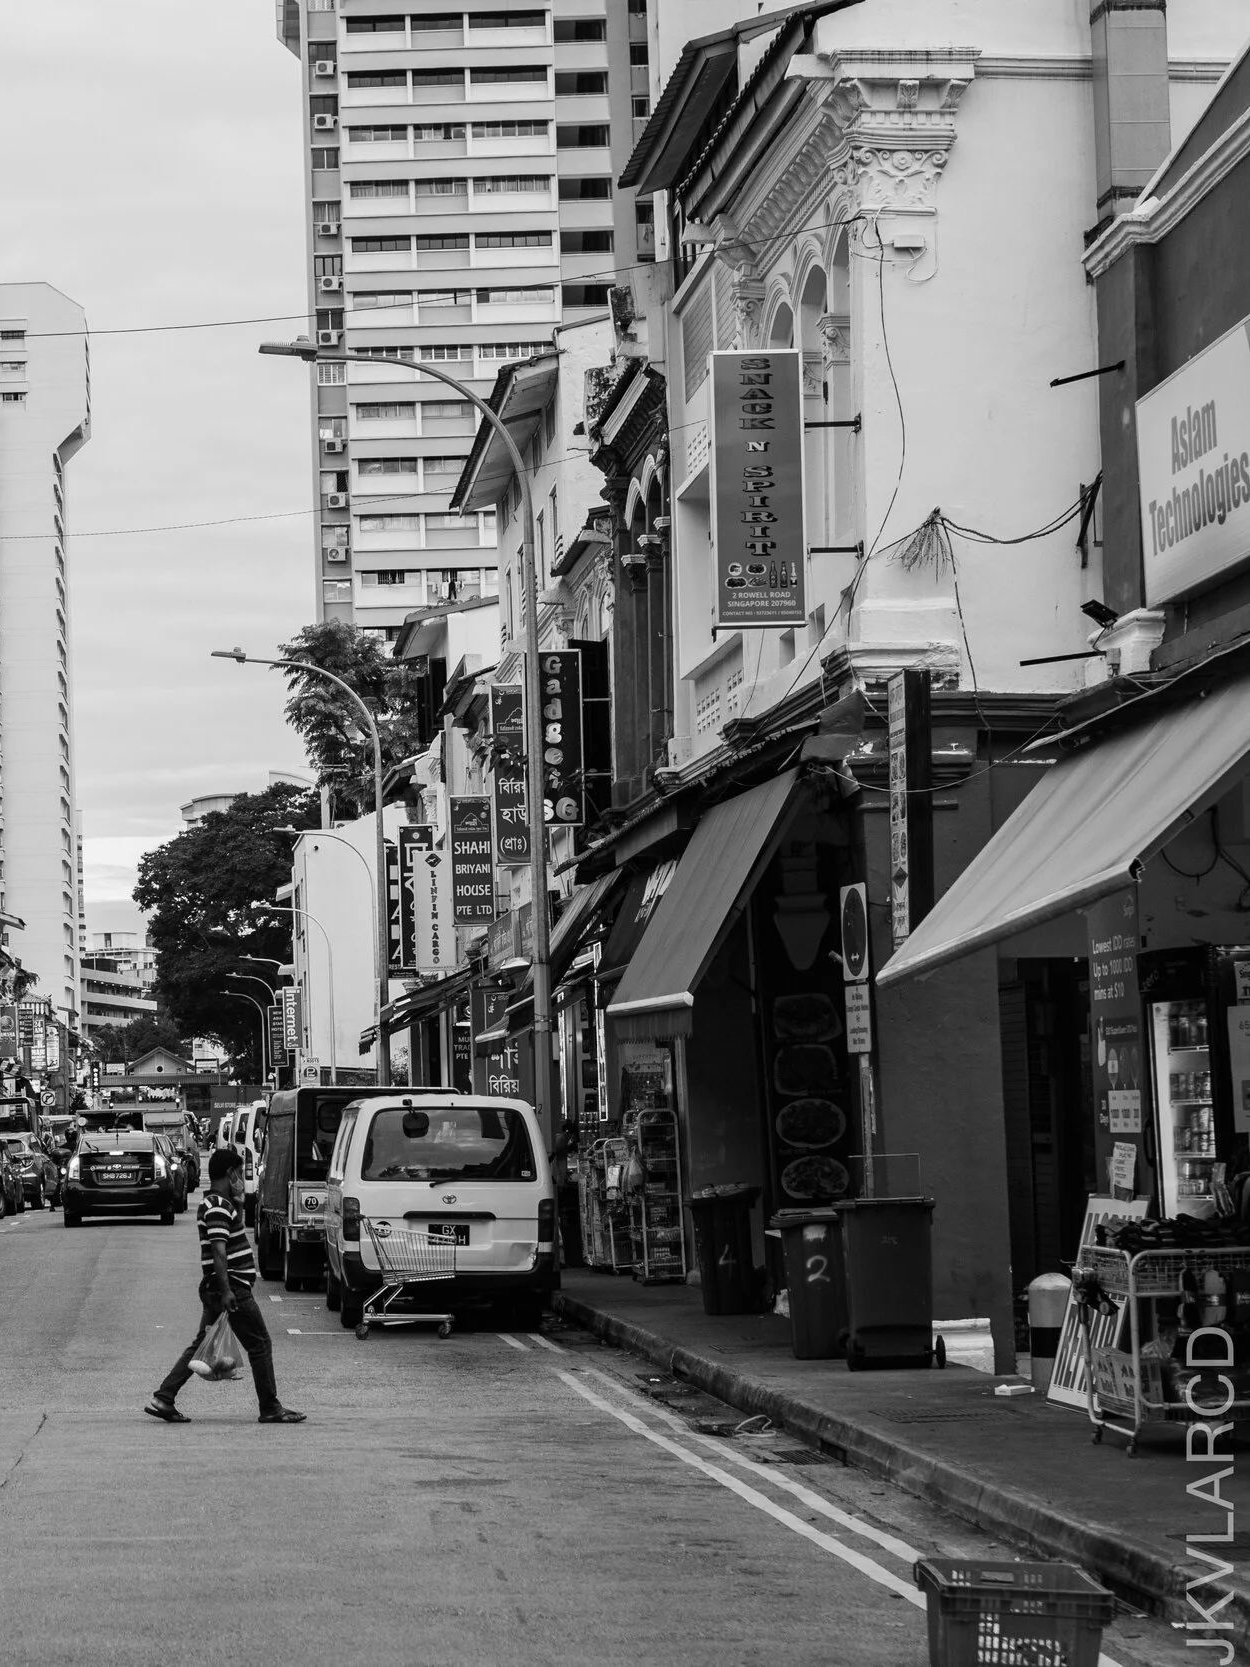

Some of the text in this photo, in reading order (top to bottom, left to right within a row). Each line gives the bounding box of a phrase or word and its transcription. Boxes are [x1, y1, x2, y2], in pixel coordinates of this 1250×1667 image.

[739, 357, 775, 429] SNACK
[745, 441, 769, 452] N
[1171, 399, 1218, 475] Aslam
[740, 466, 778, 556] SPIRIT
[1149, 451, 1250, 556] Technologies
[454, 841, 490, 854] SHAHI
[455, 864, 490, 874] BRIYANI
[456, 884, 491, 896] HOUSE
[456, 905, 492, 915] PTE LTD
[432, 924, 440, 964] CARGO
[1092, 939, 1112, 954] Lowest
[286, 989, 301, 1041] Internet
[442, 1225, 456, 1236] GX
[806, 1254, 831, 1282] 2
